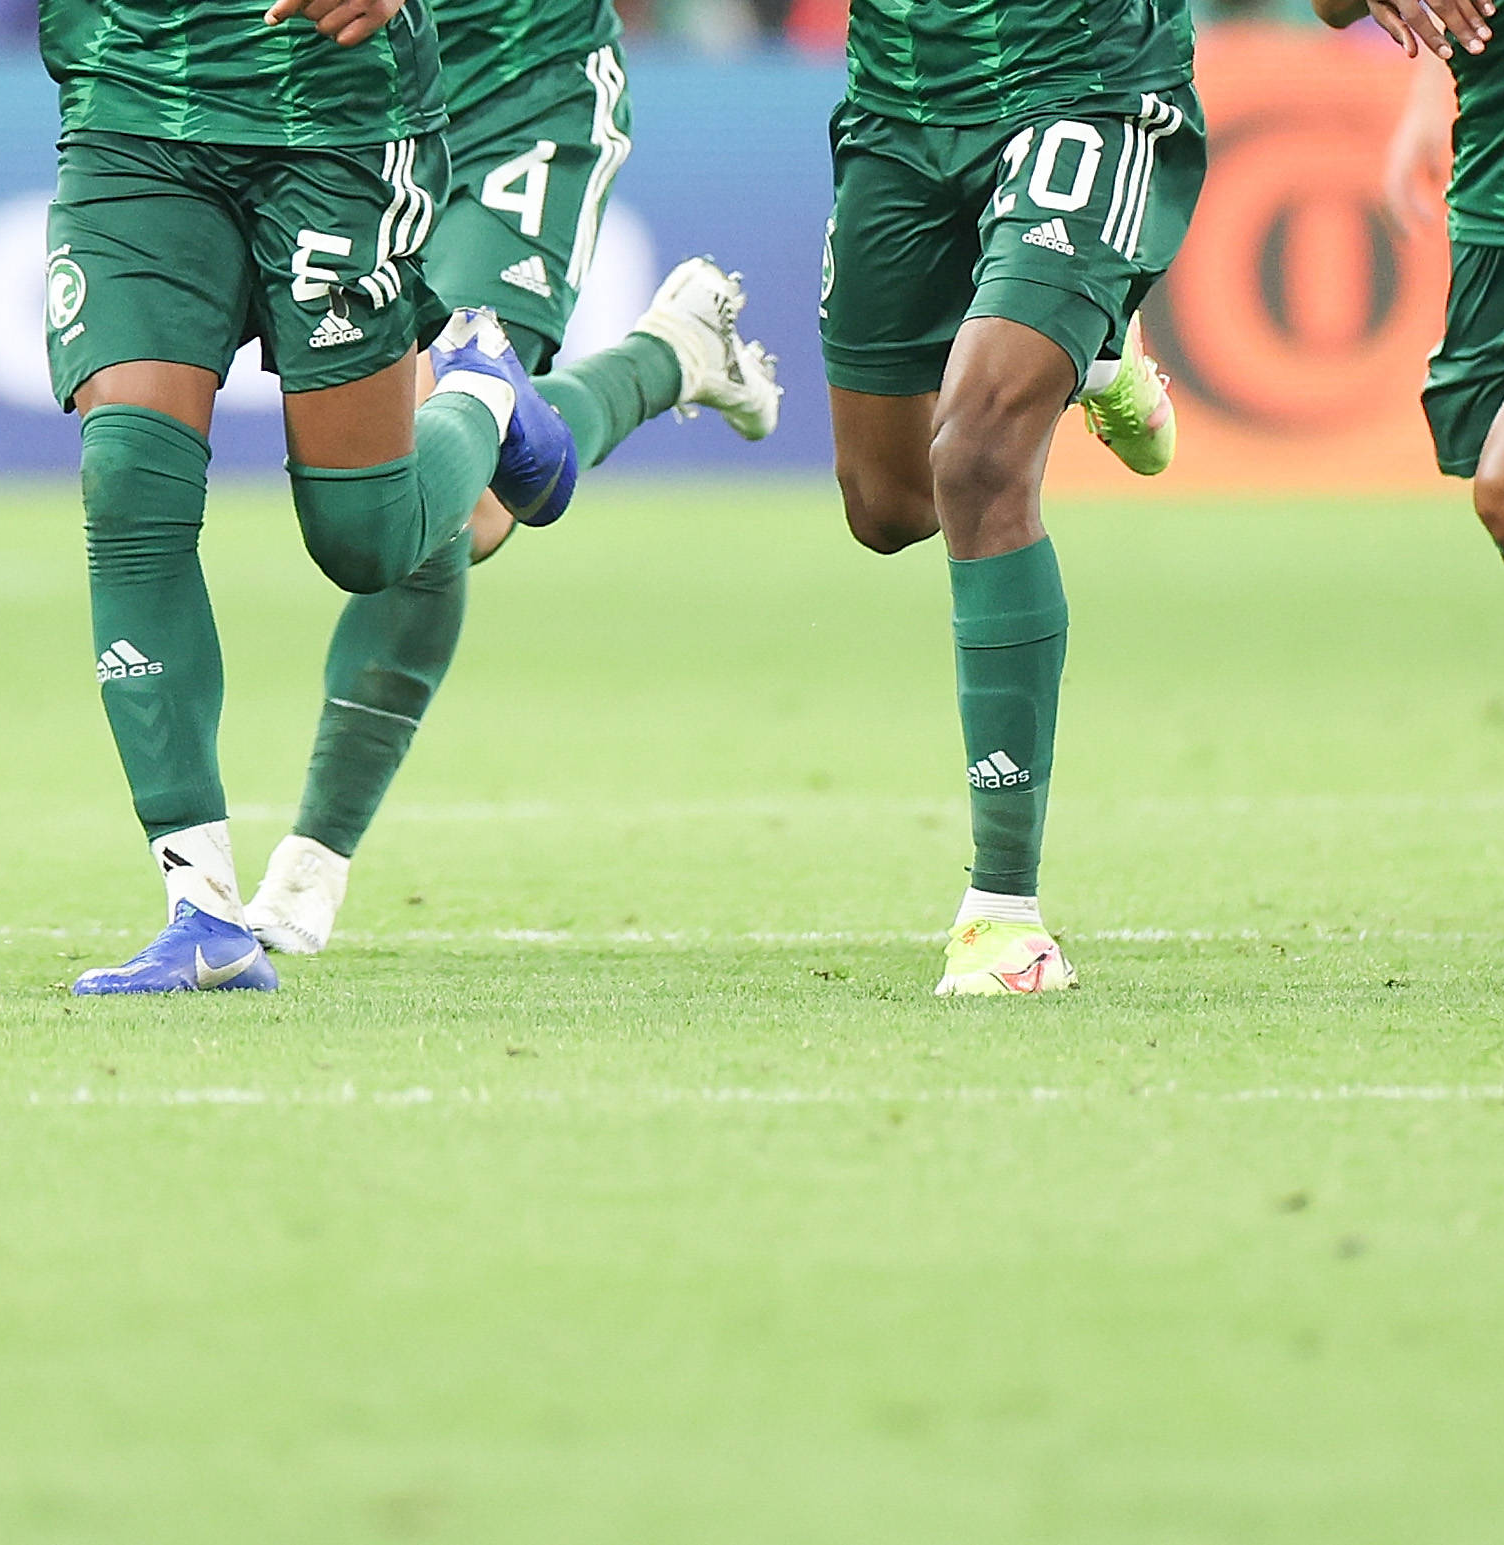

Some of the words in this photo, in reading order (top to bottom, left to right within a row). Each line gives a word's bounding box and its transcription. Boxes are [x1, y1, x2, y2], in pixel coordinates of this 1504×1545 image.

[481, 140, 558, 238] 4
[992, 119, 1105, 213] 20
[1021, 232, 1076, 257] adidas
[308, 326, 364, 348] adidas
